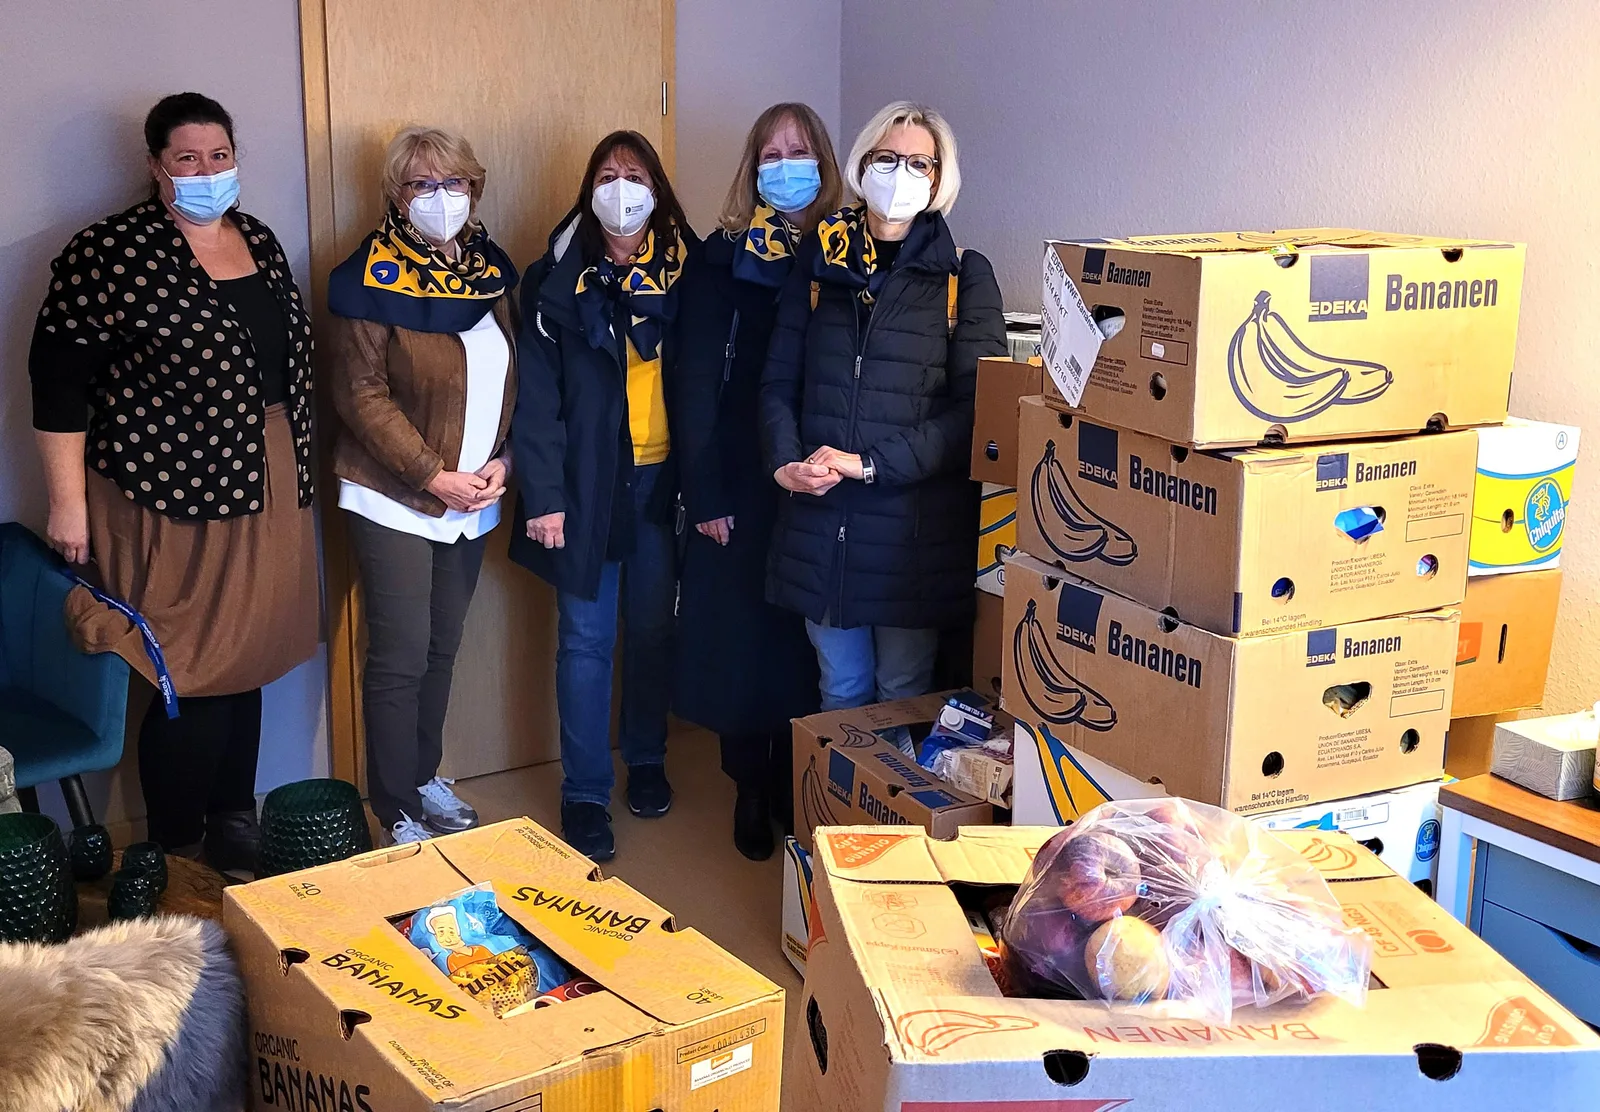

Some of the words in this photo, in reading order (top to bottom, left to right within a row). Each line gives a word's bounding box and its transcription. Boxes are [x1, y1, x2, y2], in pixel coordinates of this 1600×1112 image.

[1082, 271, 1102, 281] EDEKA
[1106, 262, 1152, 288] Bananen
[1064, 278, 1078, 300] WWF
[1076, 299, 1097, 336] Bananen
[1308, 300, 1369, 316] EDEKA
[1385, 274, 1498, 312] Bananen
[1054, 362, 1067, 384] 2710
[1078, 462, 1118, 483] EDEKA
[1130, 454, 1217, 516] Bananen
[1316, 478, 1348, 489] EDEKA
[1355, 460, 1417, 483] Bananen
[1528, 506, 1566, 546] Chiquita
[1297, 620, 1323, 630] Handling
[1056, 623, 1096, 648] EDEKA
[1108, 620, 1202, 689] Bananen
[1306, 652, 1336, 664] EDEKA
[1344, 636, 1402, 658] Bananen
[874, 752, 933, 788] Bananen
[828, 780, 852, 801] EDEKA
[834, 836, 858, 850] GUT
[301, 882, 322, 896] 40
[512, 886, 652, 934] BANANAS
[583, 924, 634, 942] ORGANIC
[1375, 940, 1400, 952] CF
[344, 948, 394, 971] ORGANIC
[320, 953, 467, 1020] BANANAS
[458, 958, 526, 996] usilli
[686, 992, 712, 1005] 40
[1083, 1022, 1321, 1043] BANANEN
[254, 1032, 300, 1062] ORGANIC
[680, 1047, 697, 1058] Product
[388, 1040, 418, 1067] DOMINICAN
[417, 1067, 444, 1090] REPUBLIC
[418, 1058, 446, 1081] PRODUCT
[258, 1057, 374, 1112] BANANAS
